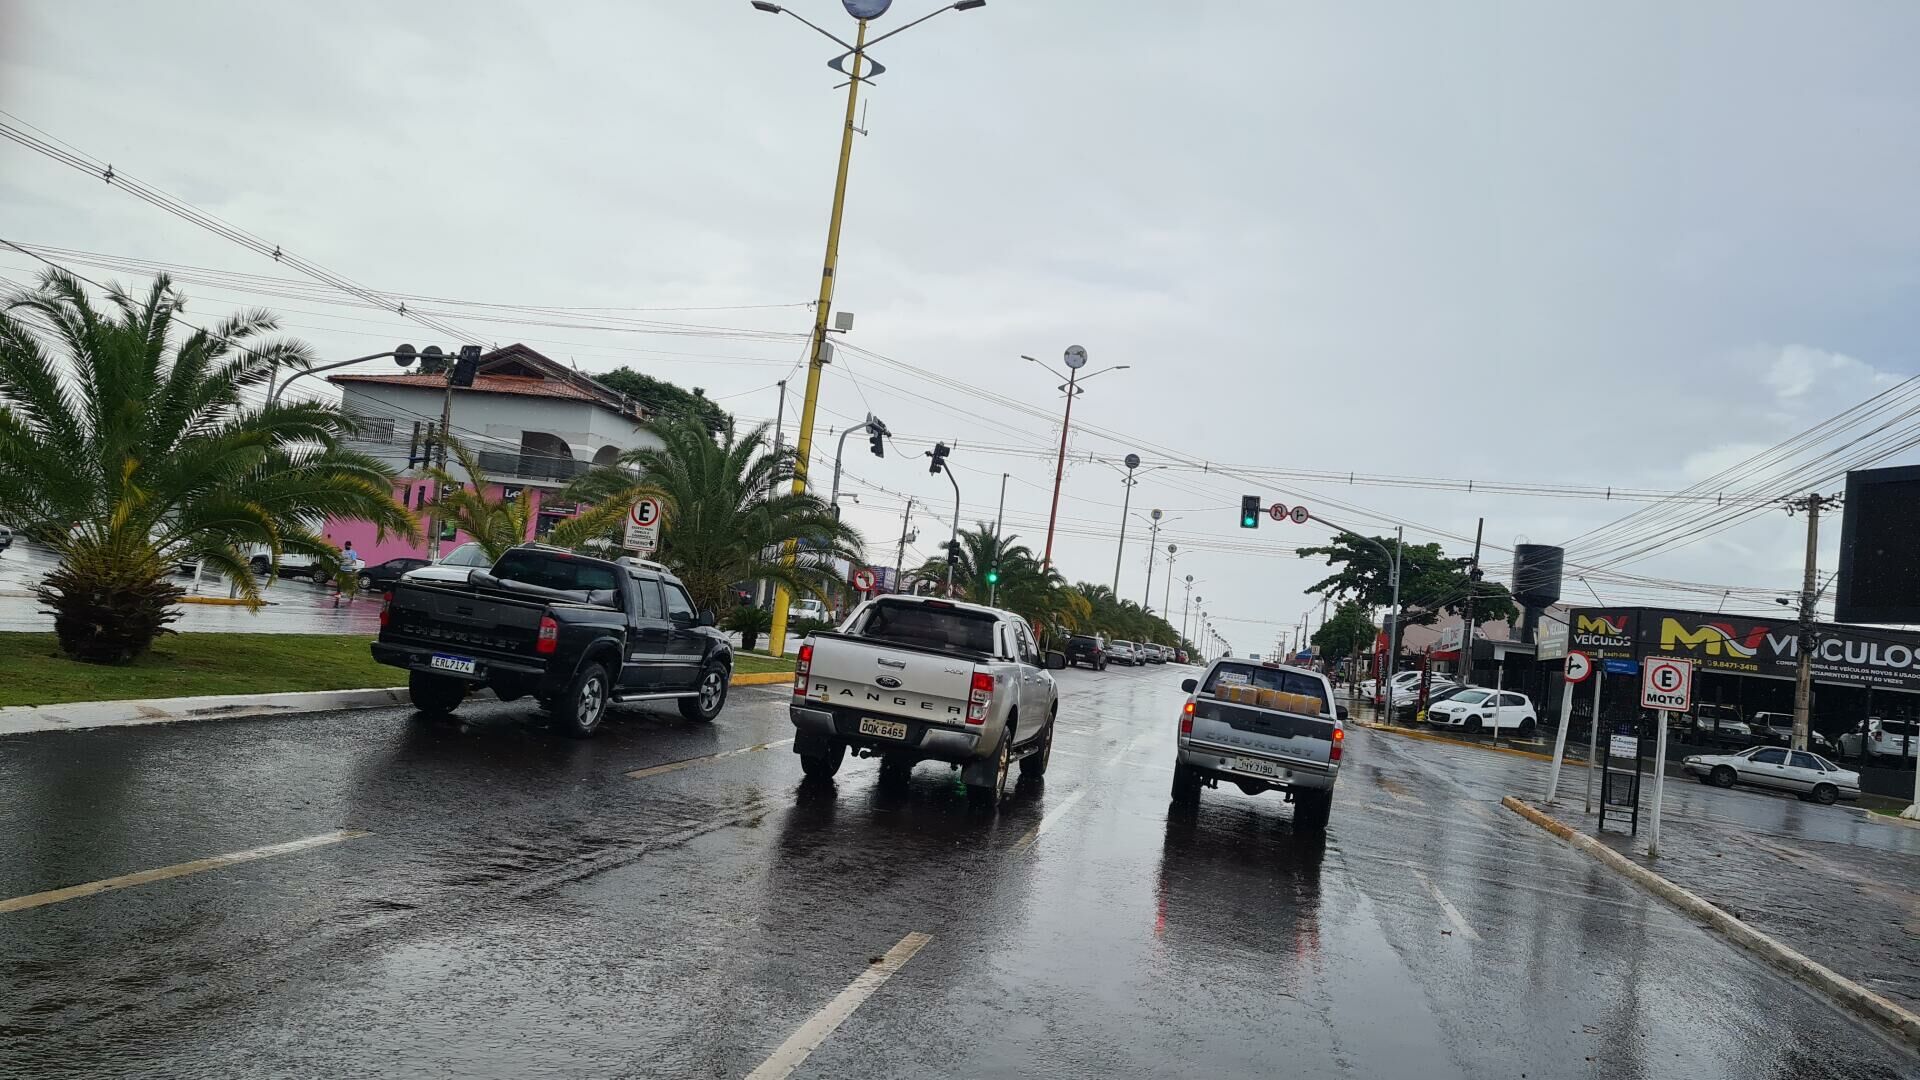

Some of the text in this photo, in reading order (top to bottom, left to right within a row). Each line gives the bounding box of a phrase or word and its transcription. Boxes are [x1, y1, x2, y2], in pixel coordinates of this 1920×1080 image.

[639, 502, 651, 521] E
[1577, 614, 1628, 635] MV
[403, 623, 519, 650] CHEVROLET
[1660, 617, 1771, 659] MV
[1661, 670, 1672, 687] E
[815, 683, 961, 715] RANGER
[1646, 693, 1685, 705] MOTO
[1205, 731, 1314, 757] CHEVROLET
